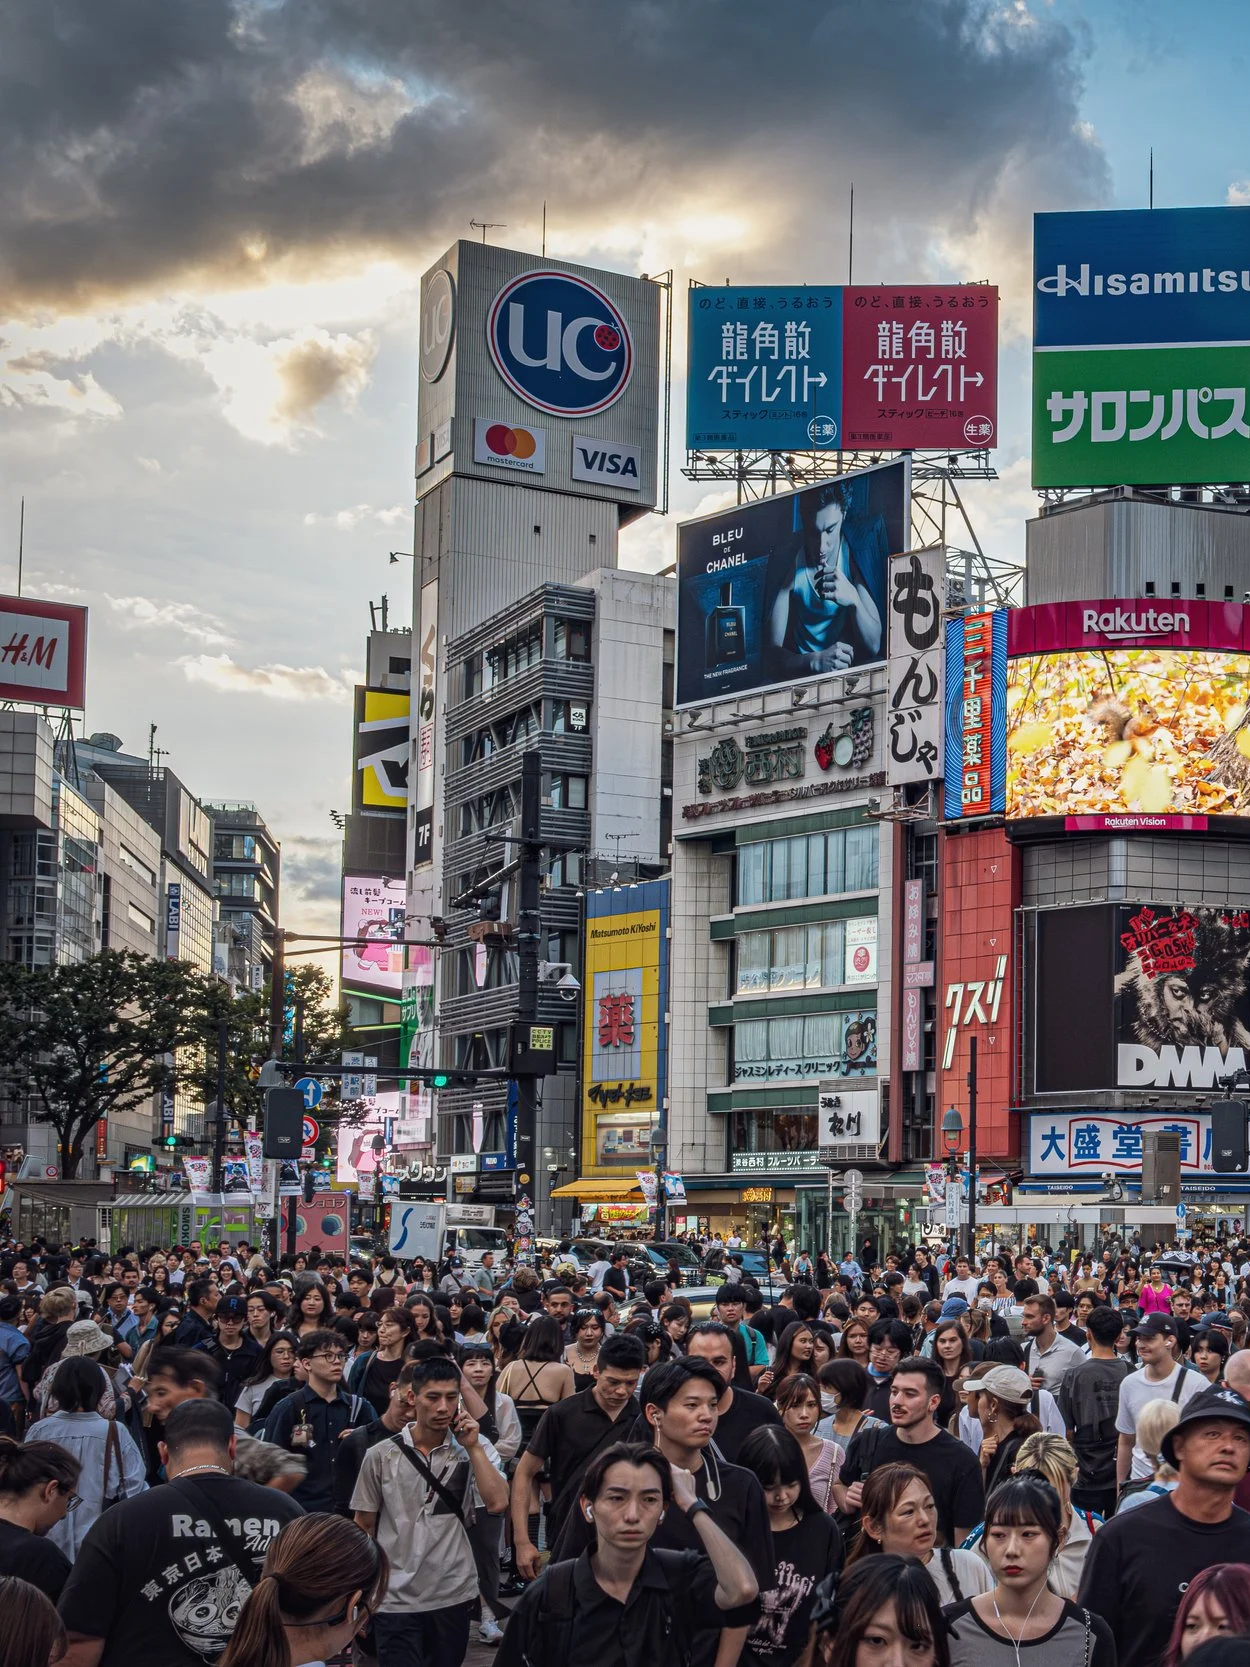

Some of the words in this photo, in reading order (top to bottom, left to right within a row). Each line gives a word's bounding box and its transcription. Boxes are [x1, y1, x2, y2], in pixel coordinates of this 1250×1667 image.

[721, 320, 811, 360] 龍角散
[878, 320, 967, 359] 龍角散
[707, 365, 828, 403] ダイレクト
[863, 364, 985, 402] ダイレクト
[1046, 387, 1250, 443] サロンパス
[809, 423, 836, 438] 生薬
[965, 423, 992, 437] 生薬
[487, 455, 534, 470] mastercard
[576, 446, 638, 478] VISA
[712, 527, 744, 546] BLEU
[706, 552, 748, 574] CHANEL
[1083, 607, 1190, 634] Rakuten
[1, 632, 58, 671] H&M
[889, 555, 940, 775] もんじゃ
[960, 621, 984, 804] 三千里薬品
[418, 824, 431, 847] 7F
[1105, 818, 1139, 827] Rakuten
[1140, 817, 1166, 826] Vision
[350, 887, 381, 896] 流し前髪
[168, 897, 180, 929] LABI
[361, 908, 383, 916] NEW!
[590, 925, 630, 939] Matsumoto
[598, 992, 635, 1048] 薬
[943, 954, 1008, 1069] クスリ
[1118, 1043, 1250, 1088] DMM
[828, 1111, 862, 1137] 松川
[735, 1156, 764, 1167] 渋谷西村
